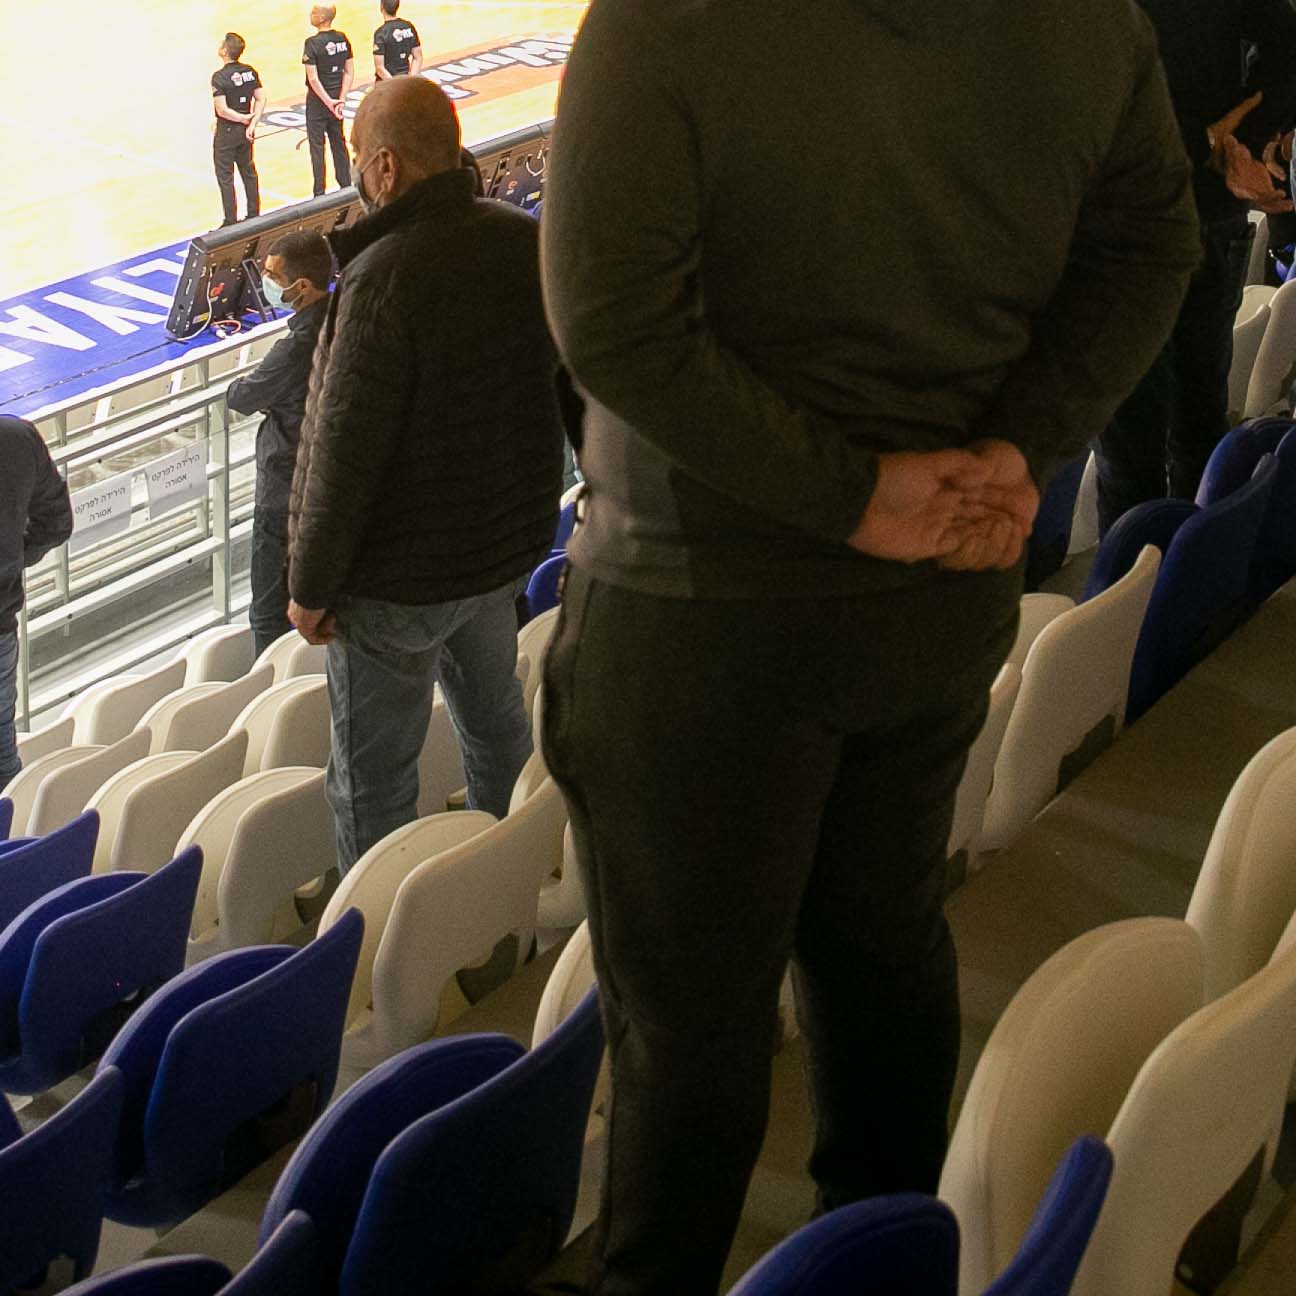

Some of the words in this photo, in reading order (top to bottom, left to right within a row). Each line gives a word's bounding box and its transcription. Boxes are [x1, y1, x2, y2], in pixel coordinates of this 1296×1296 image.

[176, 453, 200, 470] הירידה
[151, 464, 175, 482] לפרקט
[165, 473, 188, 489] אסורה
[101, 487, 126, 503] הירידה
[74, 496, 99, 514] לפרקט
[89, 507, 113, 522] אסורה
